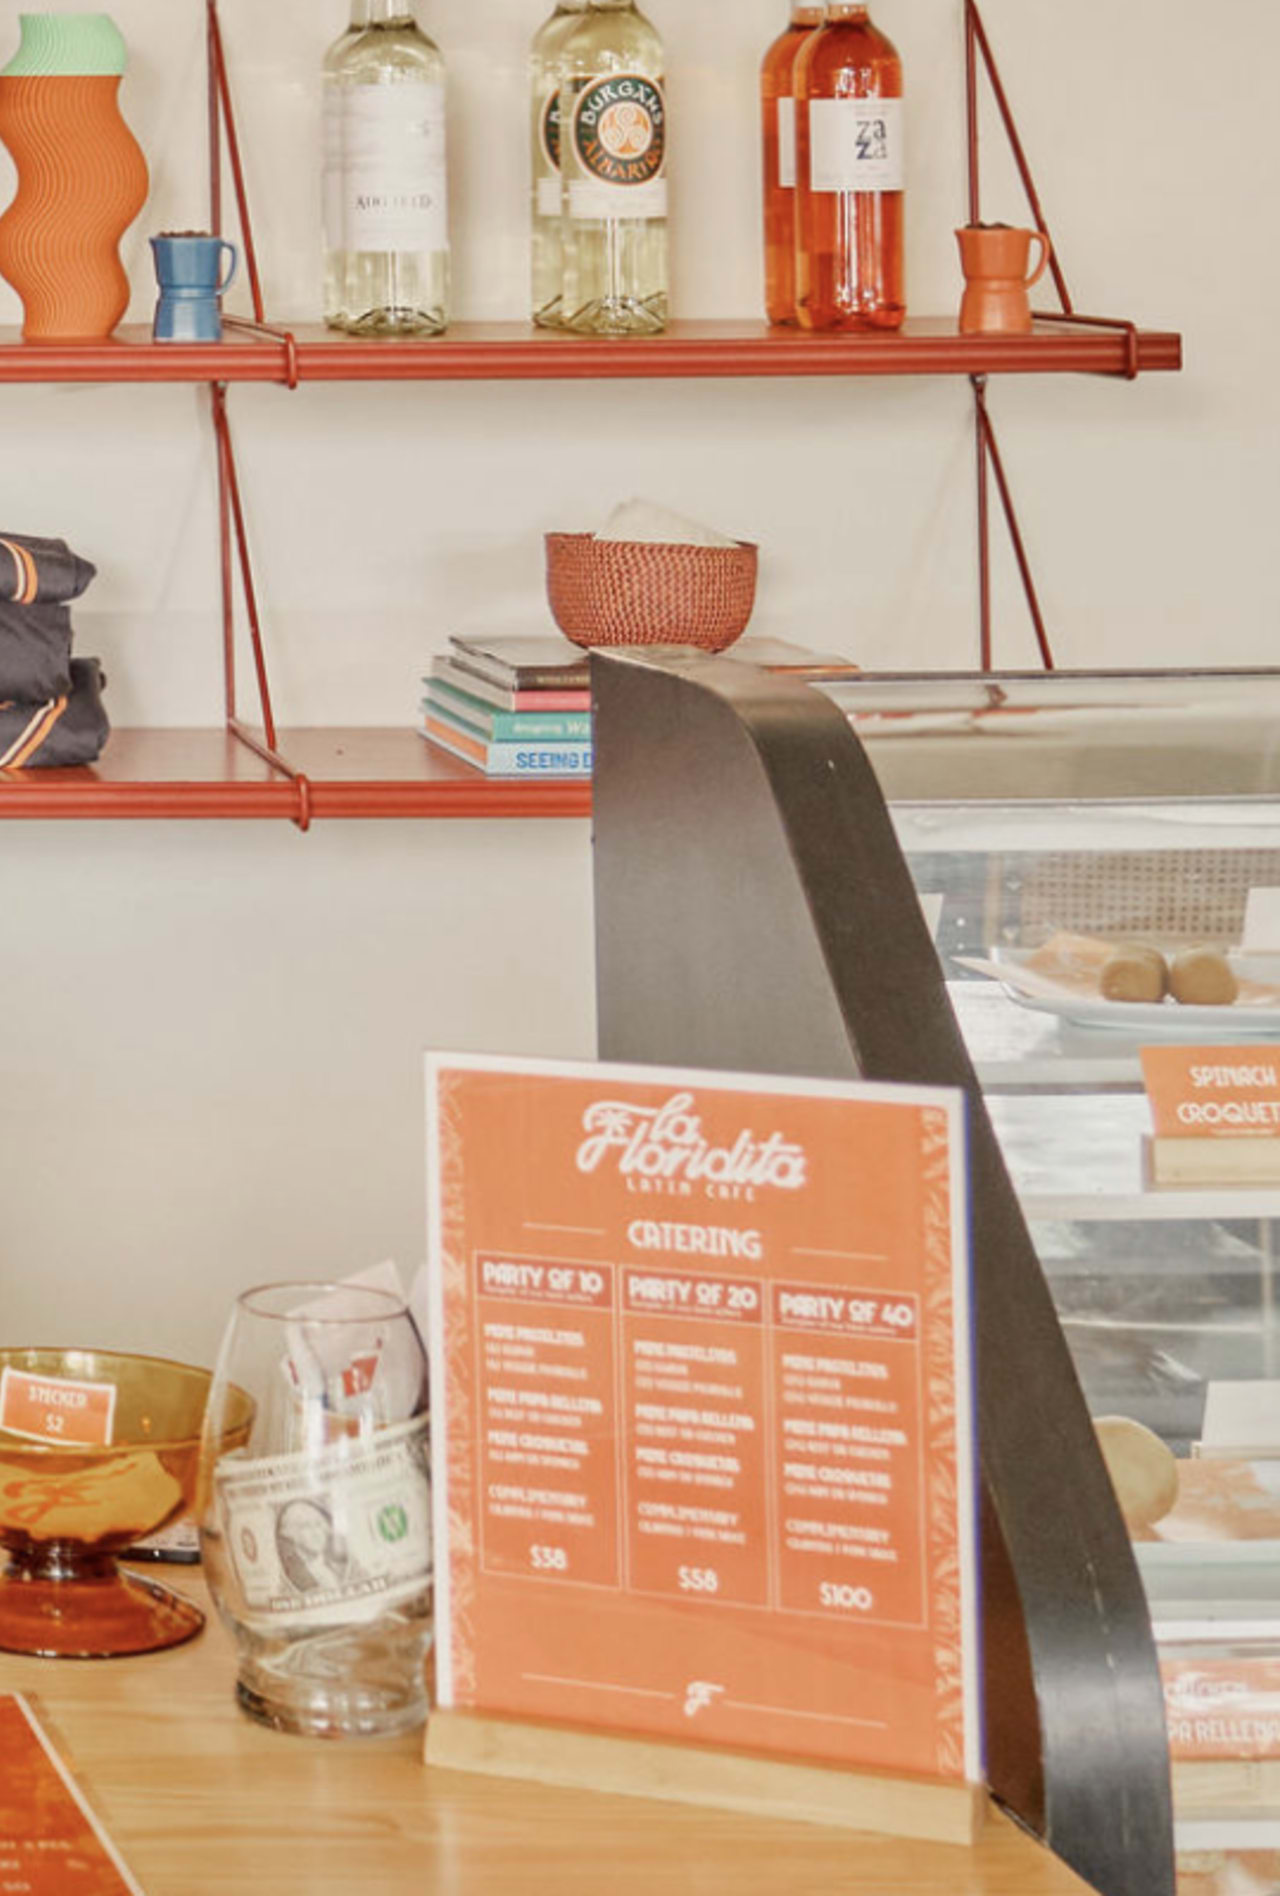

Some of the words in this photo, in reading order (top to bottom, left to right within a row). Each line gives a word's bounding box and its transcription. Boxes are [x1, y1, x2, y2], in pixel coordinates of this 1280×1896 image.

[516, 752, 580, 769] SEEING
[1189, 1065, 1277, 1088] SPINACH
[576, 1101, 808, 1190] Floridita
[627, 1219, 765, 1260] CATERING
[482, 1261, 544, 1288] PARTY
[548, 1266, 575, 1291] OF
[579, 1270, 604, 1294] 10
[628, 1276, 692, 1304] PARTY
[696, 1282, 725, 1308] OF
[727, 1286, 759, 1310] 20
[779, 1292, 845, 1321] PARTY
[848, 1298, 877, 1324] OF
[880, 1304, 914, 1327] 40
[819, 1581, 873, 1611] $100
